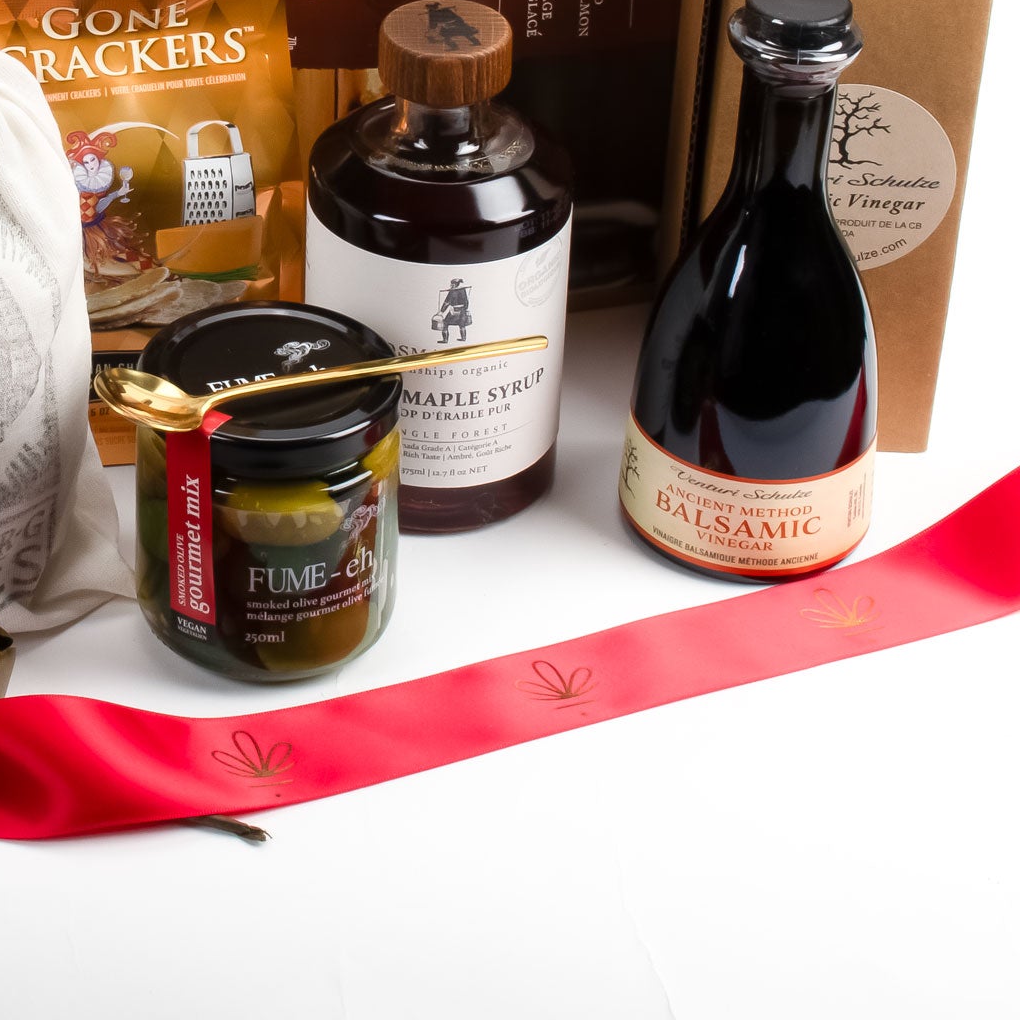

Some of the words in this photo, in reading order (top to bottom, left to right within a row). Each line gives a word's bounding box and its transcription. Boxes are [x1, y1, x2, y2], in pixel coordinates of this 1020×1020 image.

[41, 0, 190, 41] GONE
[70, 88, 101, 100] CRACKERS
[166, 79, 184, 90] POUR
[185, 77, 204, 88] TOUTE
[847, 172, 941, 190] Schulze
[849, 193, 926, 215] Vinegar
[879, 221, 893, 229] DE
[894, 221, 907, 229] LA
[908, 222, 922, 230] CB
[854, 237, 908, 263] ulze.com
[462, 360, 509, 376] organic
[403, 389, 480, 408] MAPLE
[487, 367, 545, 403] SYRUP
[422, 409, 484, 421] D'ÉRABLE
[488, 403, 511, 416] PUR
[401, 428, 439, 439] NGLE
[451, 423, 508, 439] FOREST
[469, 465, 488, 475] NET
[180, 474, 200, 518] mix
[669, 465, 740, 497] Venturi
[743, 489, 813, 502] Schulze
[666, 483, 735, 514] ANCIENT
[739, 505, 813, 518] METHOD
[656, 489, 822, 539] BALSAMIC
[176, 533, 185, 564] OLIVE
[652, 525, 683, 548] VINAIGRE
[685, 543, 736, 564] BALSAMIQUE
[737, 556, 779, 566] MÉTHODE
[780, 552, 819, 566] ANCIENNE
[696, 530, 773, 551] VINEGAR
[185, 520, 210, 615] gourmet
[247, 562, 327, 594] FUME
[177, 564, 186, 607] SMOKED
[247, 599, 290, 610] smoked
[292, 598, 317, 609] olive
[320, 583, 361, 606] gourmet
[247, 611, 294, 623] mélange
[296, 604, 340, 622] gourmet
[342, 594, 362, 609] olive
[177, 616, 207, 635] VEGAN
[245, 631, 285, 644] 250ml
